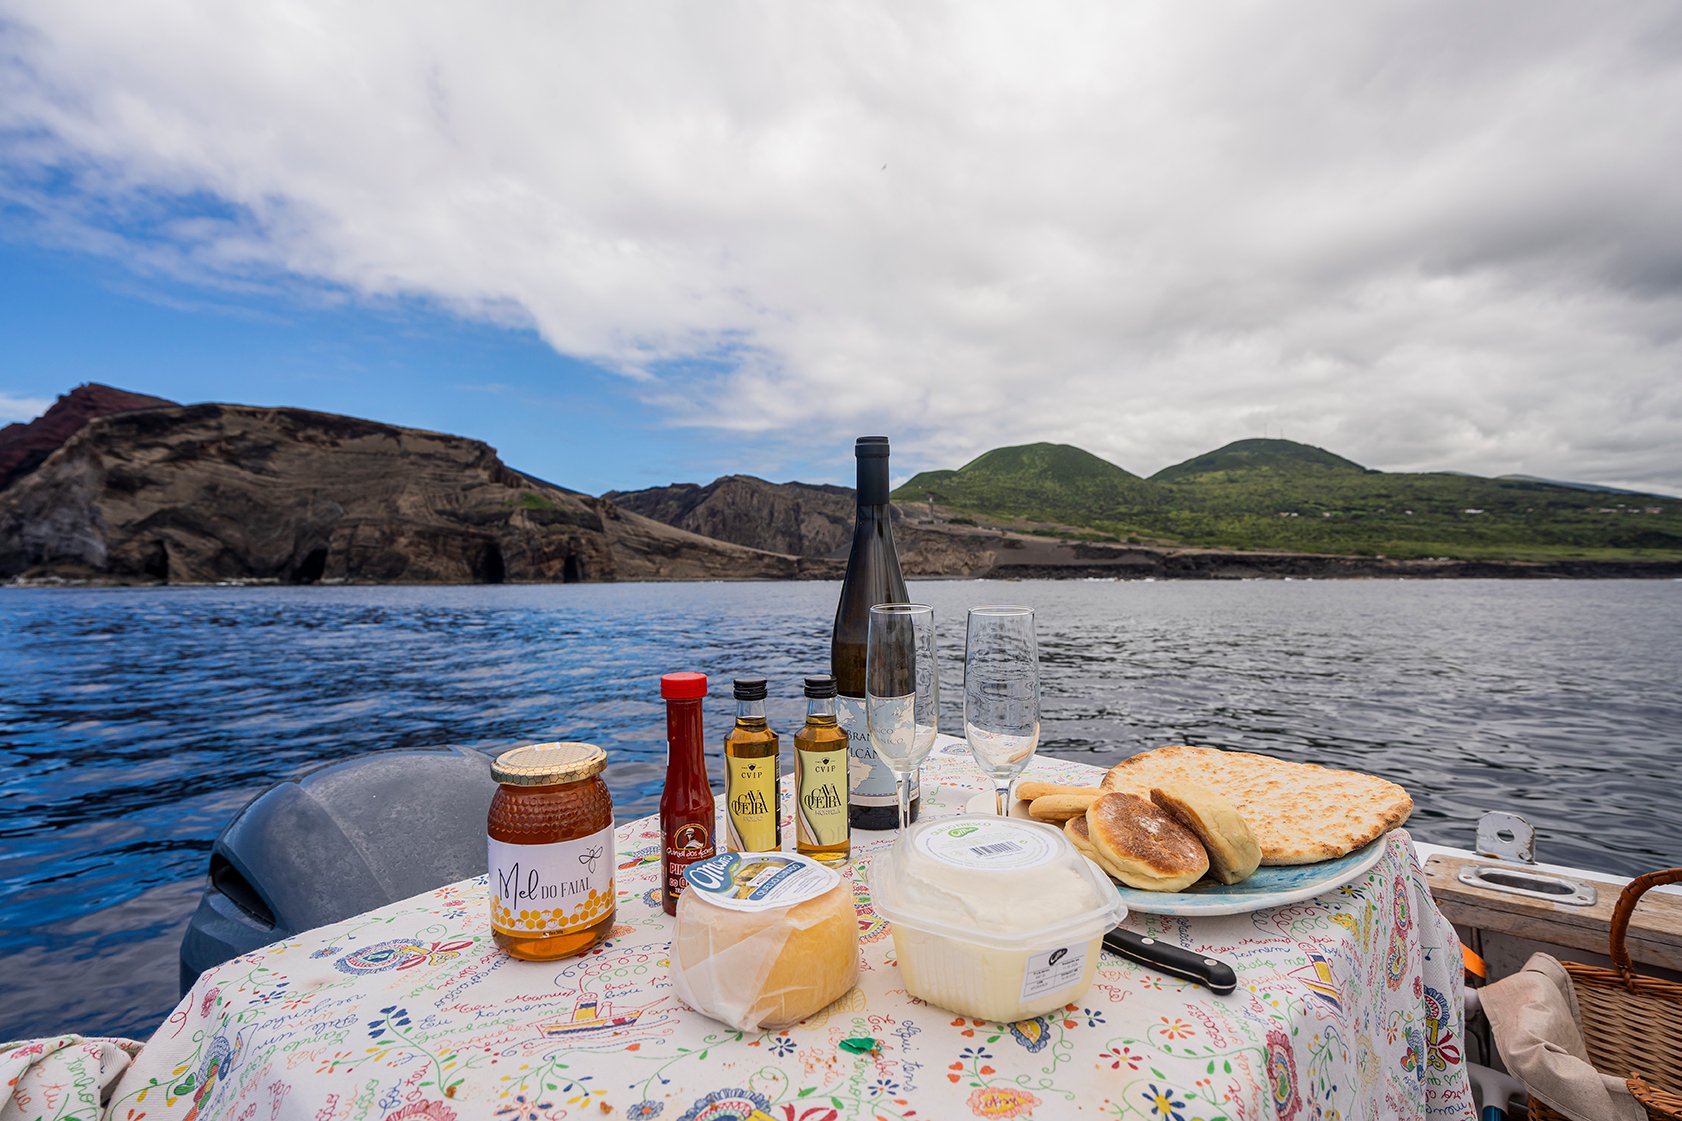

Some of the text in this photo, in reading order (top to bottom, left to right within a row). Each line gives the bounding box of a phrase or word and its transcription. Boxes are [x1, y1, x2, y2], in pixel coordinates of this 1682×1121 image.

[815, 766, 836, 774] CVIP
[498, 862, 592, 910] Mel DO FAIAL
[756, 878, 780, 896] QUEIJO
[778, 864, 801, 882] CURADO
[417, 1014, 453, 1030] Eu
